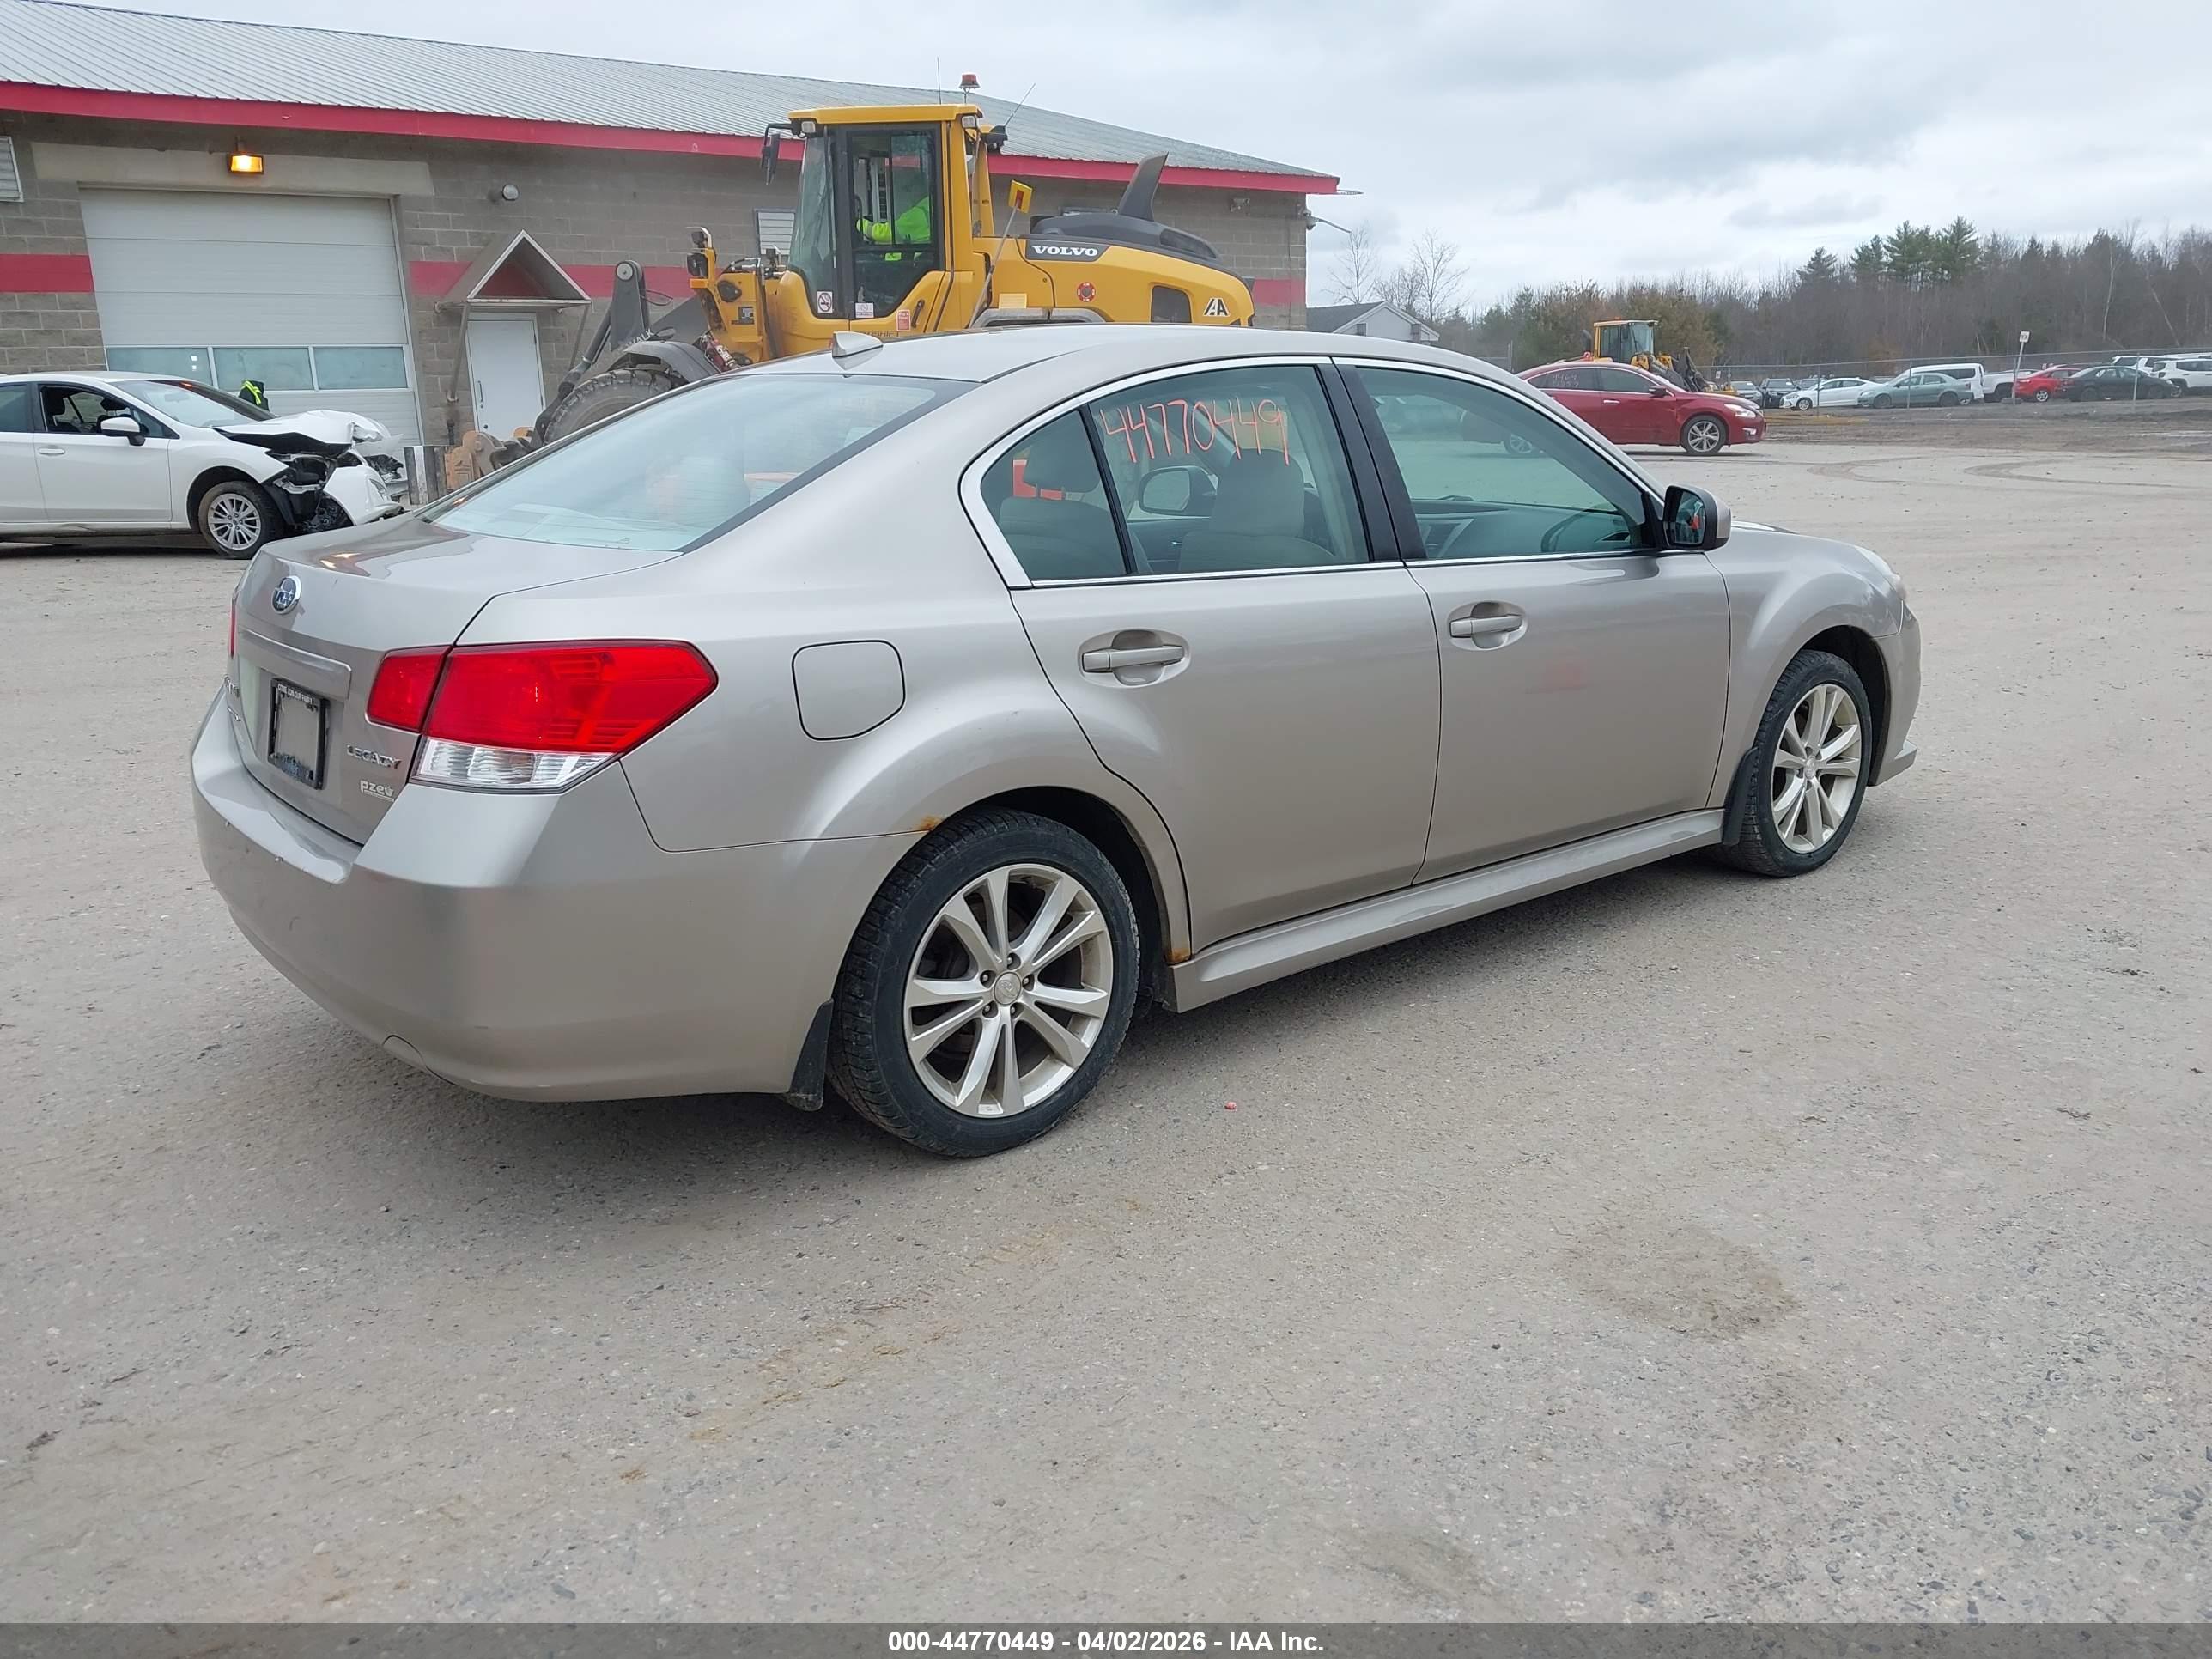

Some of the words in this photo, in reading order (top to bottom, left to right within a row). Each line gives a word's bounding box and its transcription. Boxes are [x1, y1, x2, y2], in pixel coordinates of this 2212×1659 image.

[1032, 246, 1098, 257] VOLVO
[1099, 396, 1290, 466] 44770449
[346, 744, 402, 770] LEGACY
